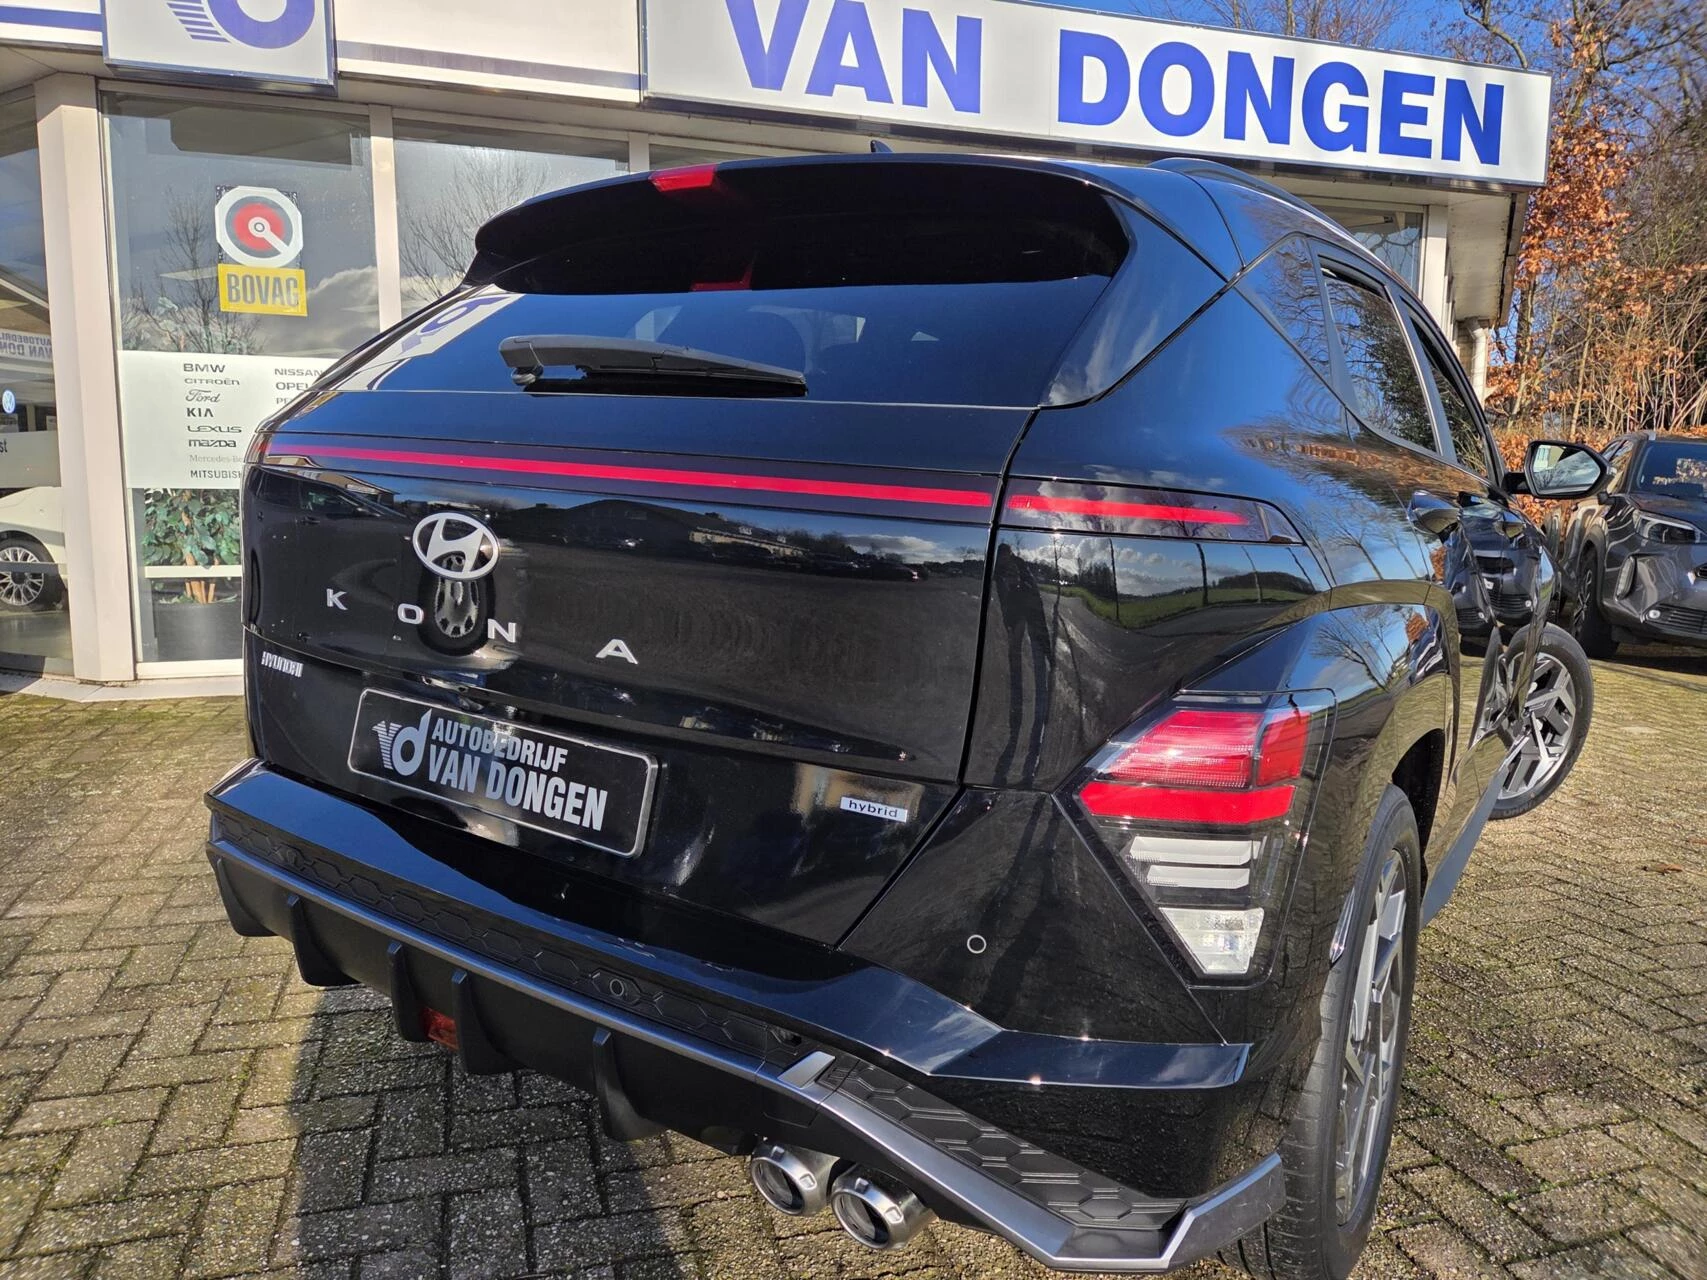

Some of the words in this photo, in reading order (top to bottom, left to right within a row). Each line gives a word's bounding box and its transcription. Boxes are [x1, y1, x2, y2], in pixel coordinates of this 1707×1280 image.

[725, 0, 983, 114] VAN
[1057, 29, 1505, 166] DONGEN
[226, 273, 300, 308] BOVAG
[183, 363, 226, 373] BMW
[185, 389, 221, 403] Ford
[186, 407, 214, 417] KIA
[187, 425, 242, 433] LEXUS
[261, 651, 304, 678] HYUNDAI
[431, 717, 569, 773] AUTOBEDRIJF
[428, 744, 481, 794] VAN
[485, 762, 609, 832] DONGEN
[848, 800, 898, 818] hybrid
